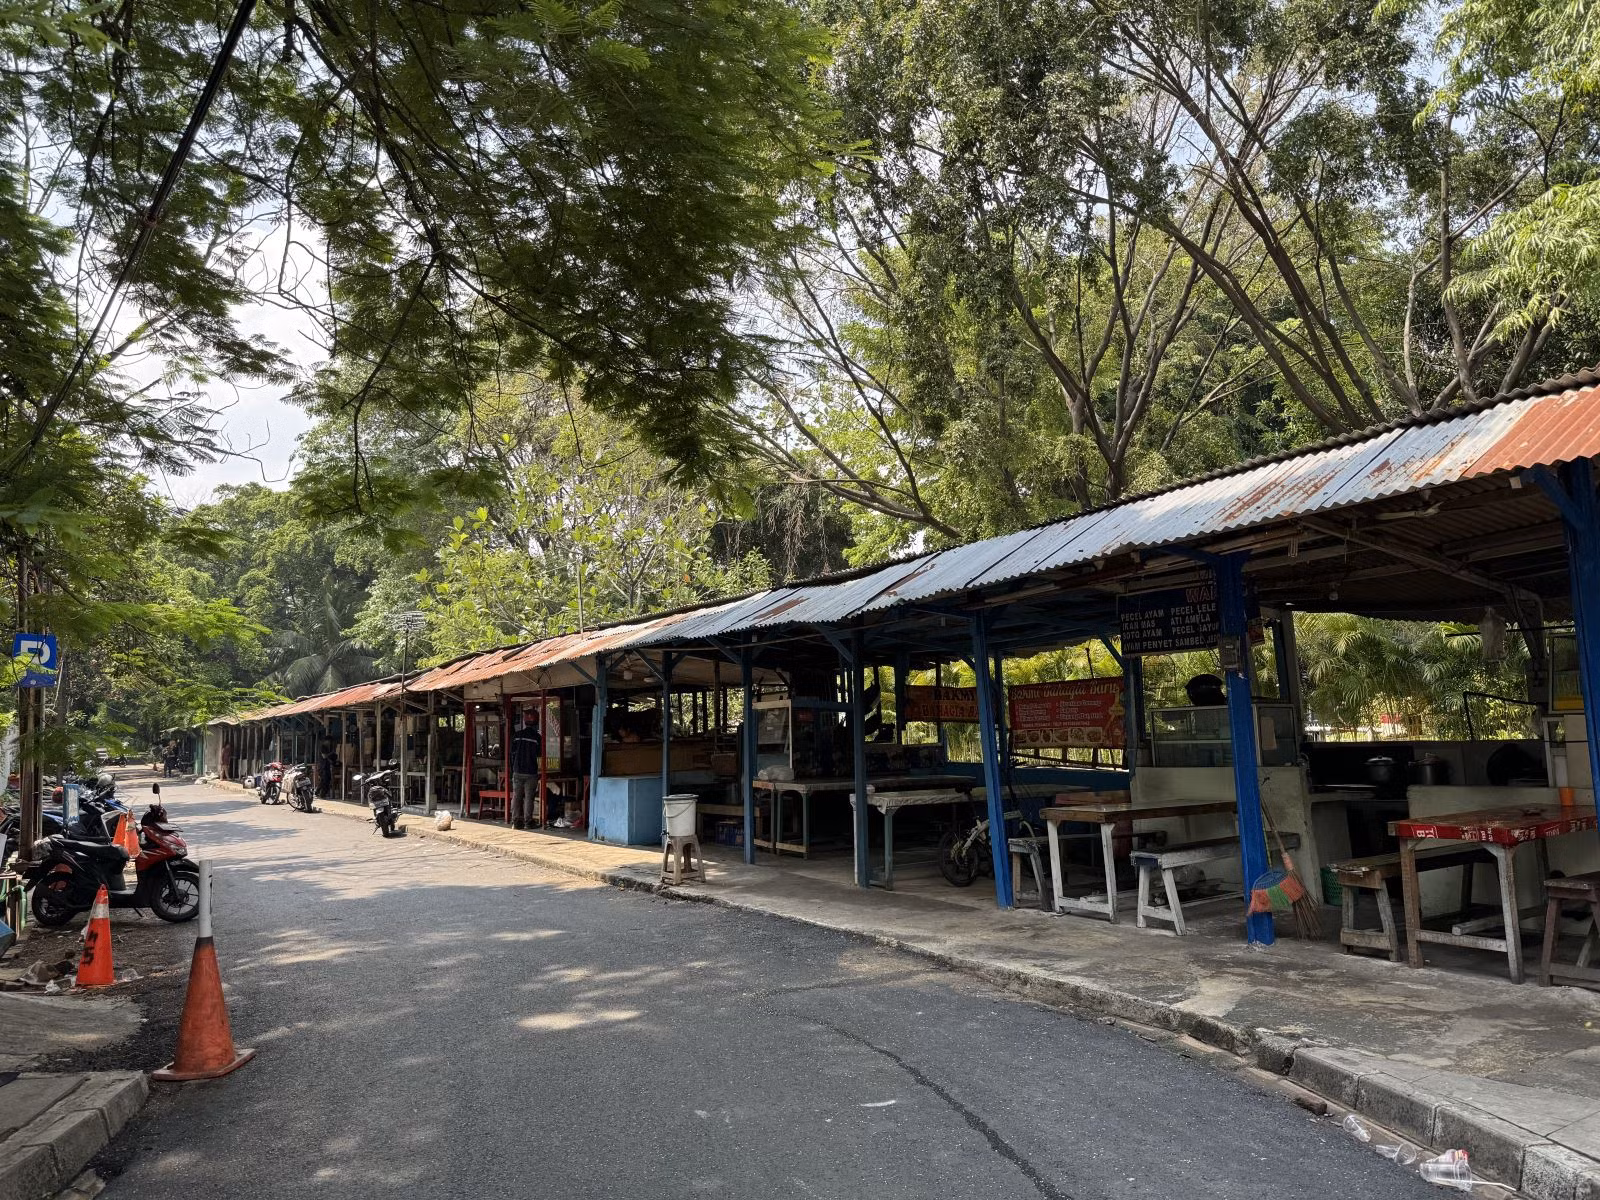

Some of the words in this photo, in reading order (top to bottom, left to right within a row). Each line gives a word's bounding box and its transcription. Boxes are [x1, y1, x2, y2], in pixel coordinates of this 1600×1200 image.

[1170, 605, 1194, 616] PECEL
[1197, 602, 1216, 613] LELE
[1121, 612, 1143, 622] PECEL
[1144, 609, 1165, 620] AYAM
[1170, 616, 1183, 626] ATI
[1141, 619, 1156, 630] MAS
[1171, 625, 1196, 636] PECEL
[1122, 630, 1140, 640] SOTO
[1142, 628, 1163, 638] AYAM
[1123, 641, 1141, 652] AYAM
[1142, 639, 1173, 650] PENYET
[1175, 636, 1204, 647] SAMBEL
[20, 640, 50, 677] P
